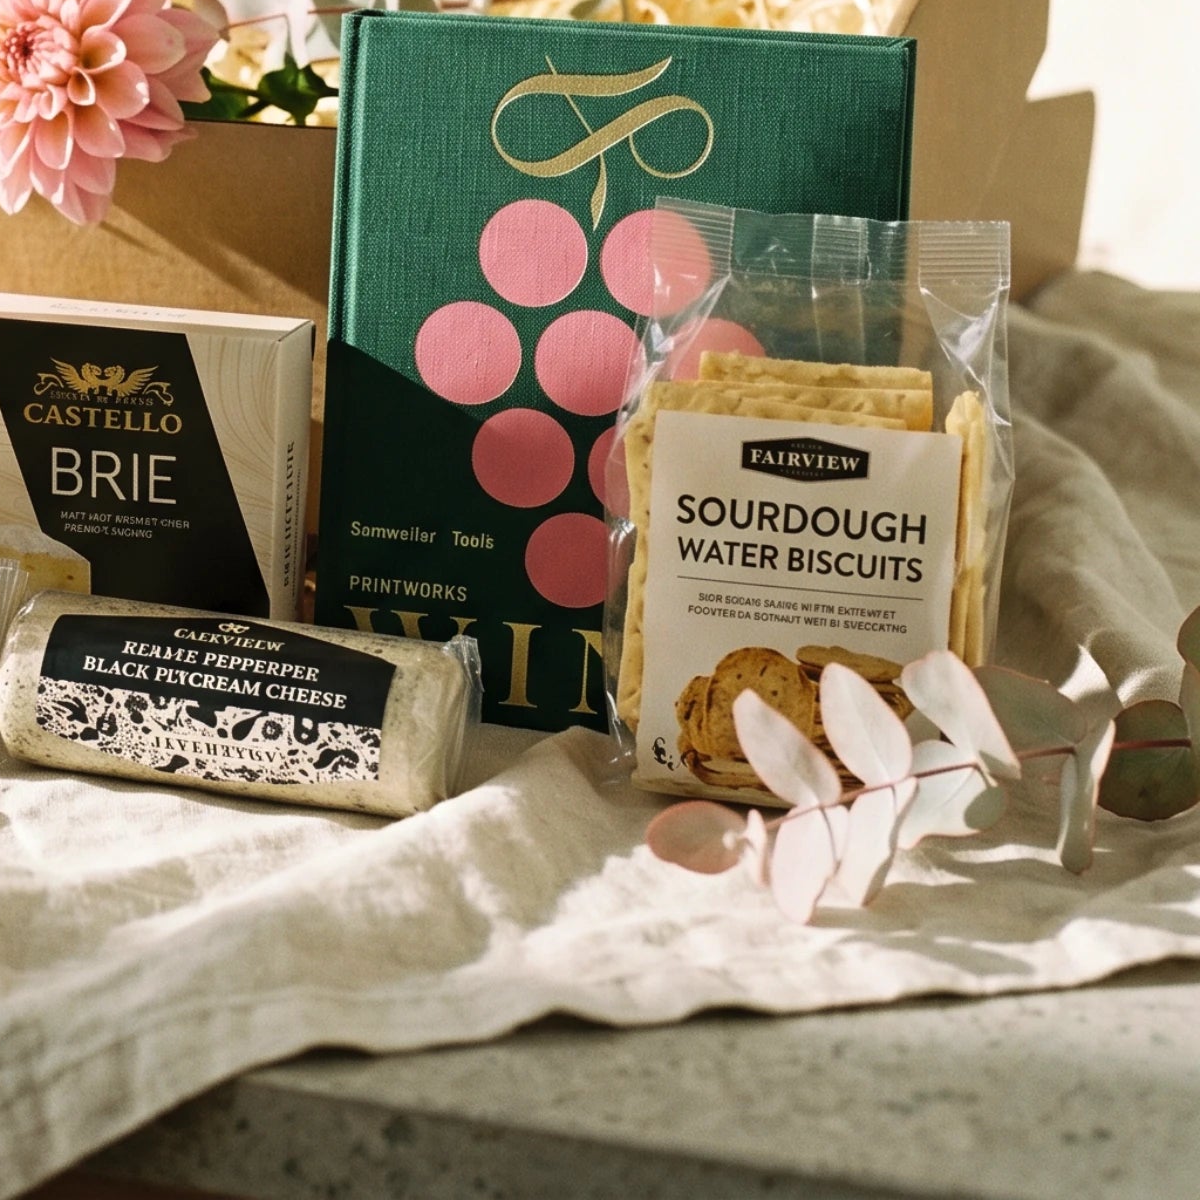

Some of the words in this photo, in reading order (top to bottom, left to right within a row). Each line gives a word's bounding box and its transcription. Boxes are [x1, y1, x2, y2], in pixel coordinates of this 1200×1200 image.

[23, 403, 183, 435] CASTELLO
[51, 447, 177, 505] BRIE
[750, 449, 860, 472] FAIRVIEW
[676, 494, 927, 544] SOURDOUGH
[677, 536, 778, 570] WATER
[787, 547, 923, 583] BISCUITS
[350, 573, 467, 602] PRINTWORKS
[83, 655, 150, 680] BLACK
[265, 683, 348, 709] CHEESE
